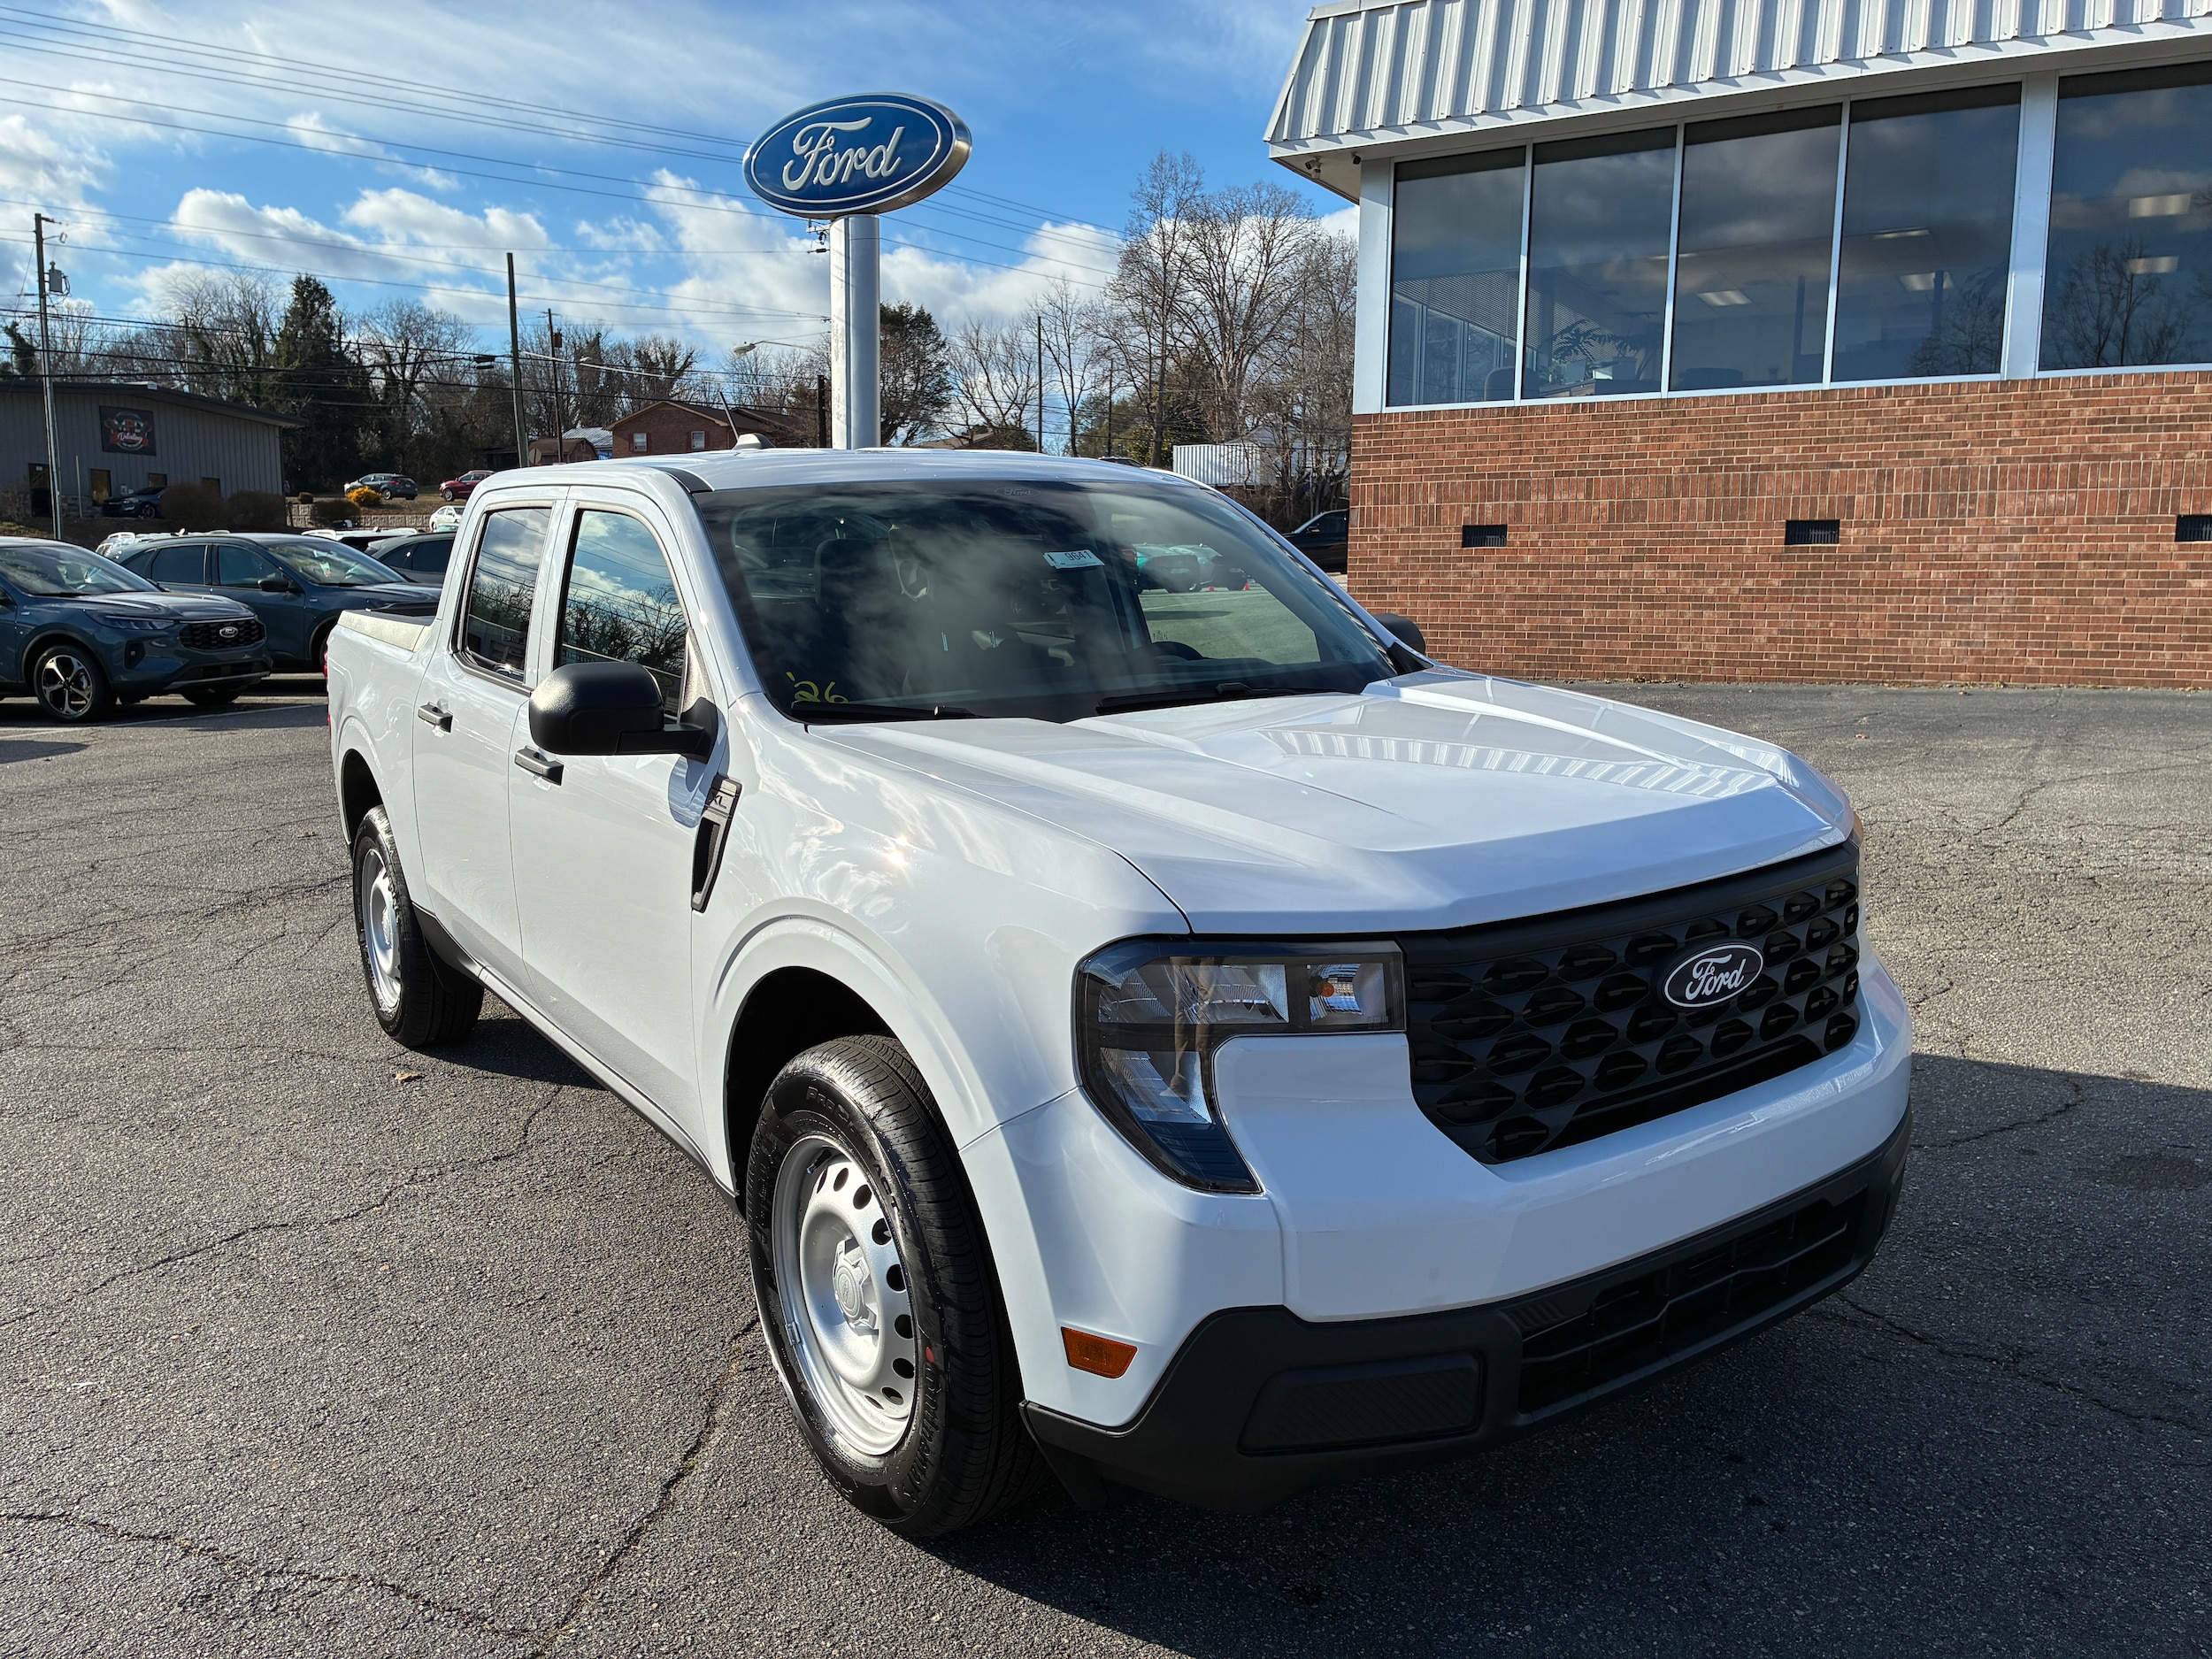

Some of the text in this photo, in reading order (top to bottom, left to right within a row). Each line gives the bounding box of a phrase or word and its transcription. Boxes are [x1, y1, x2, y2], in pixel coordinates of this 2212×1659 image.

[782, 116, 906, 191] Ford
[1064, 550, 1093, 561] 9641
[709, 795, 727, 809] XL
[1685, 954, 1747, 1001] Ford
